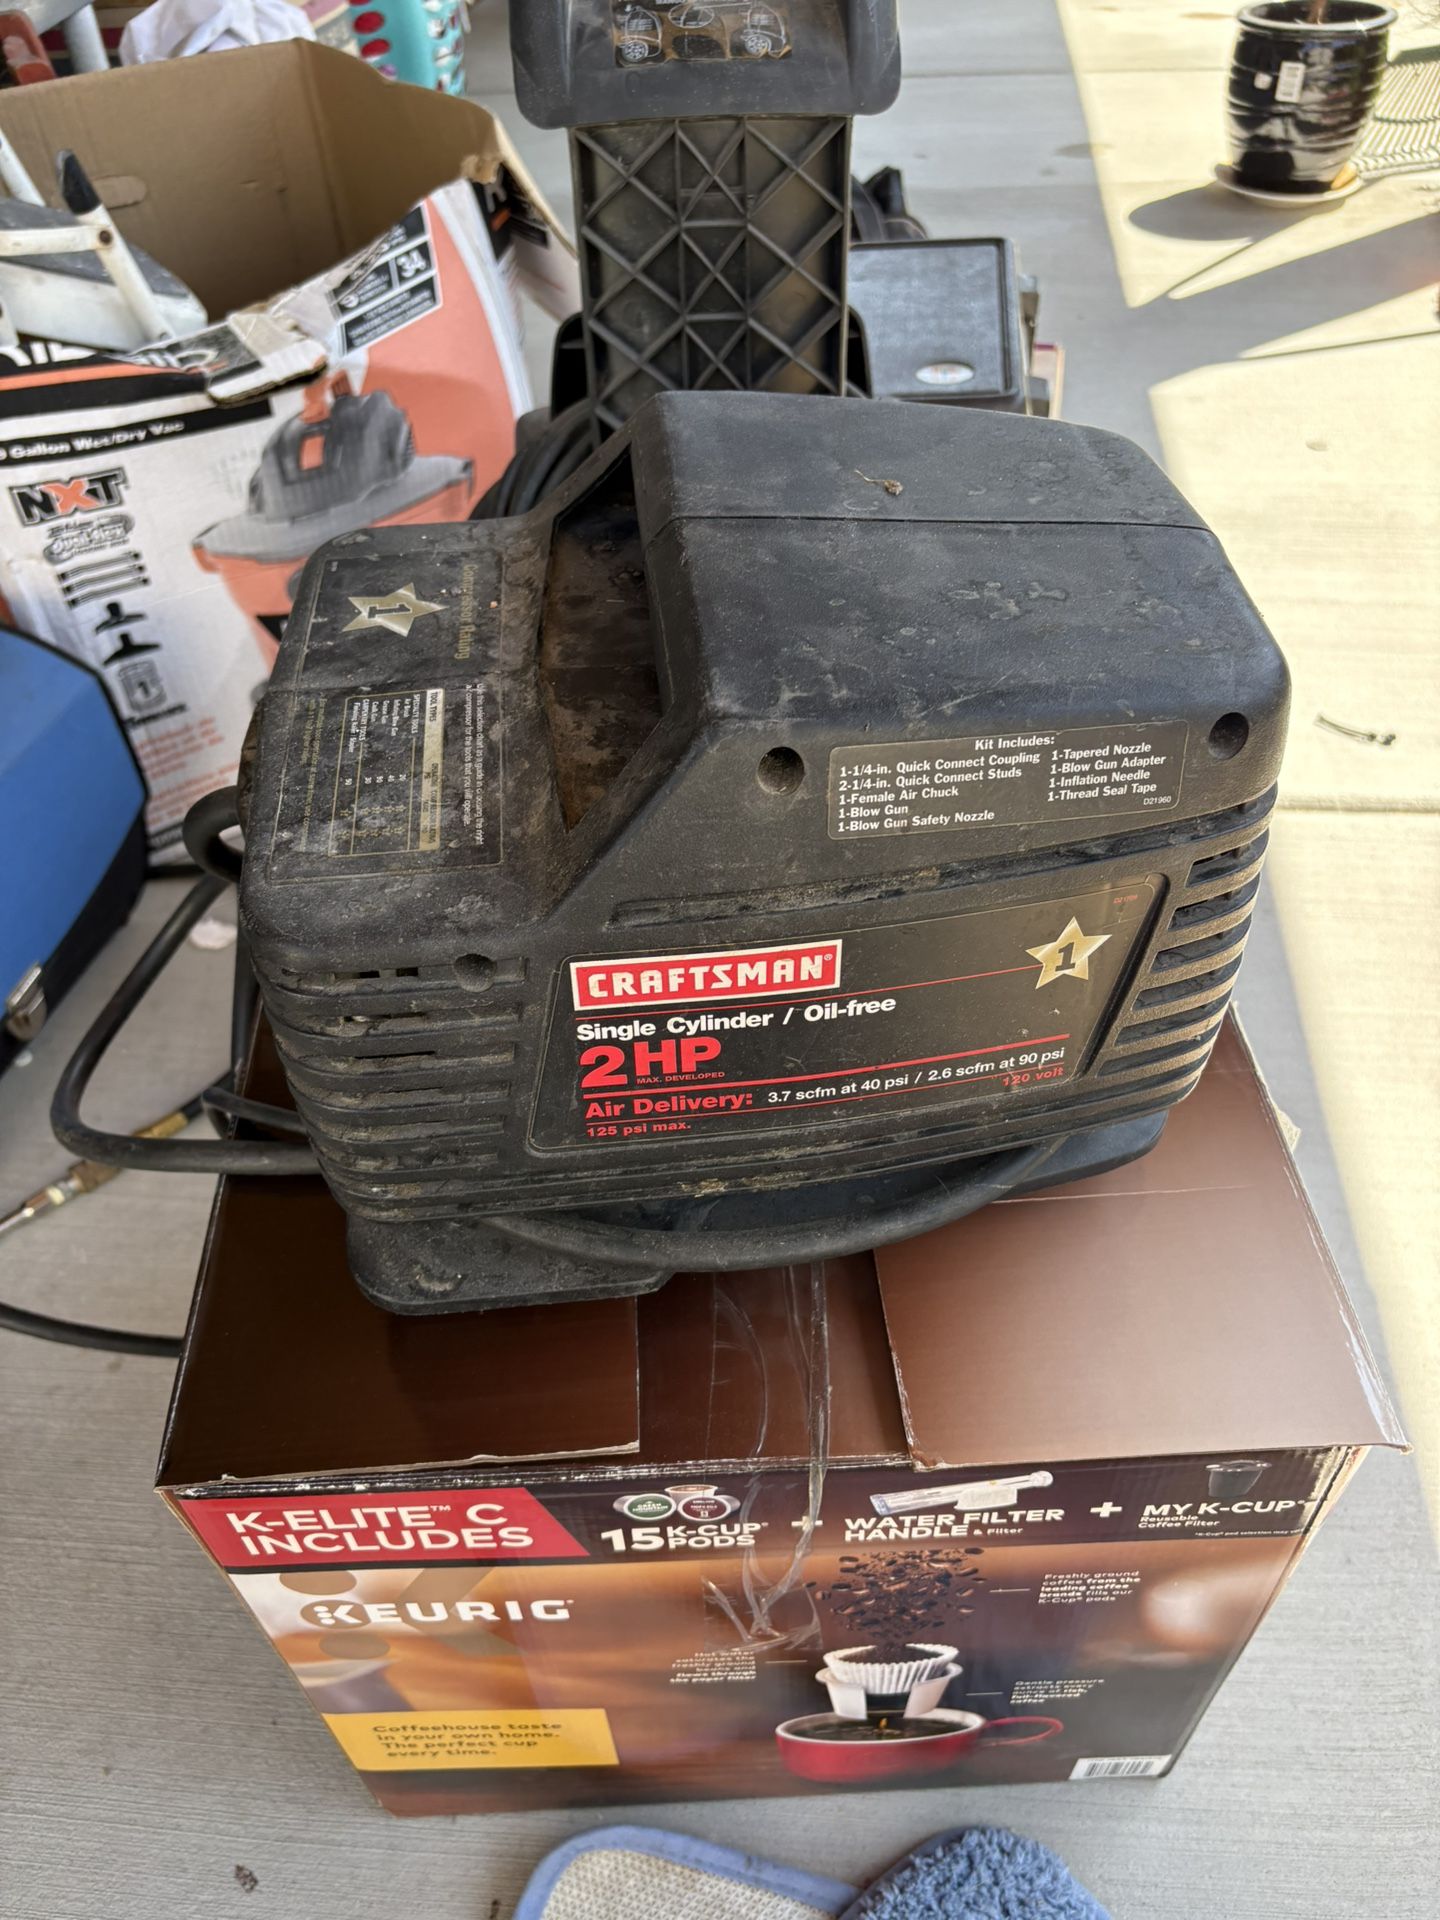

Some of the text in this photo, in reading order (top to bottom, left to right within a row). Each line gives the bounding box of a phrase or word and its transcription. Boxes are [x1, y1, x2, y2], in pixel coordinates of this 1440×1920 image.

[9, 467, 125, 527] NXT
[368, 603, 412, 619] 1
[454, 565, 477, 659] Compressor Rating
[476, 707, 484, 732] selection
[476, 733, 484, 748] chart
[975, 735, 1055, 750] Kit Includes:
[1052, 742, 1151, 760] 1-Tapered Nozzle
[840, 752, 1040, 777] 1-1/4-in. Quick Connect Coupling
[1050, 755, 1166, 774] 1-Blow Gun Adapter
[839, 767, 1022, 791] 2-1/4-in. Quick Connect Studs
[1048, 770, 1150, 788] 1-Inflation Needle
[839, 786, 959, 805] 1-Female Air Chuck
[1048, 783, 1157, 801] 1-Thread Seal Tape
[1143, 796, 1172, 805] D21960
[838, 804, 909, 818] 1-Blow Gun
[838, 810, 995, 832] 1-Blow Gun Safety Nozzle
[1055, 941, 1076, 972] 1
[576, 998, 896, 1042] Single Cylinder / Oil-free
[579, 1037, 722, 1089] 2 HP
[585, 1048, 1065, 1120] Air Delivery: 3.7 scfm at 40 psi / 2.6 scfm at 90 psi
[637, 1071, 726, 1085] MAX. DEVELOPED
[1002, 1067, 1063, 1087] 120 volt
[587, 1122, 691, 1137] 125 psi max.
[465, 1503, 508, 1525] C
[1143, 1503, 1192, 1516] MY
[844, 1513, 956, 1530] WATER
[964, 1509, 1065, 1525] FILTER
[1138, 1520, 1221, 1529] Coffee Filter
[240, 1526, 534, 1556] INCLUDES
[601, 1527, 665, 1552] 15
[668, 1534, 756, 1549] PODS
[844, 1525, 969, 1542] HANDLE
[987, 1527, 1024, 1535] Filter
[1045, 1572, 1090, 1580] Freshly
[372, 1723, 501, 1732] Coffeehouse
[377, 1733, 396, 1741] in
[401, 1733, 445, 1741] your
[499, 1731, 560, 1739] home.
[424, 1740, 498, 1749] perfect
[503, 1739, 538, 1747] cup
[386, 1750, 439, 1758] every
